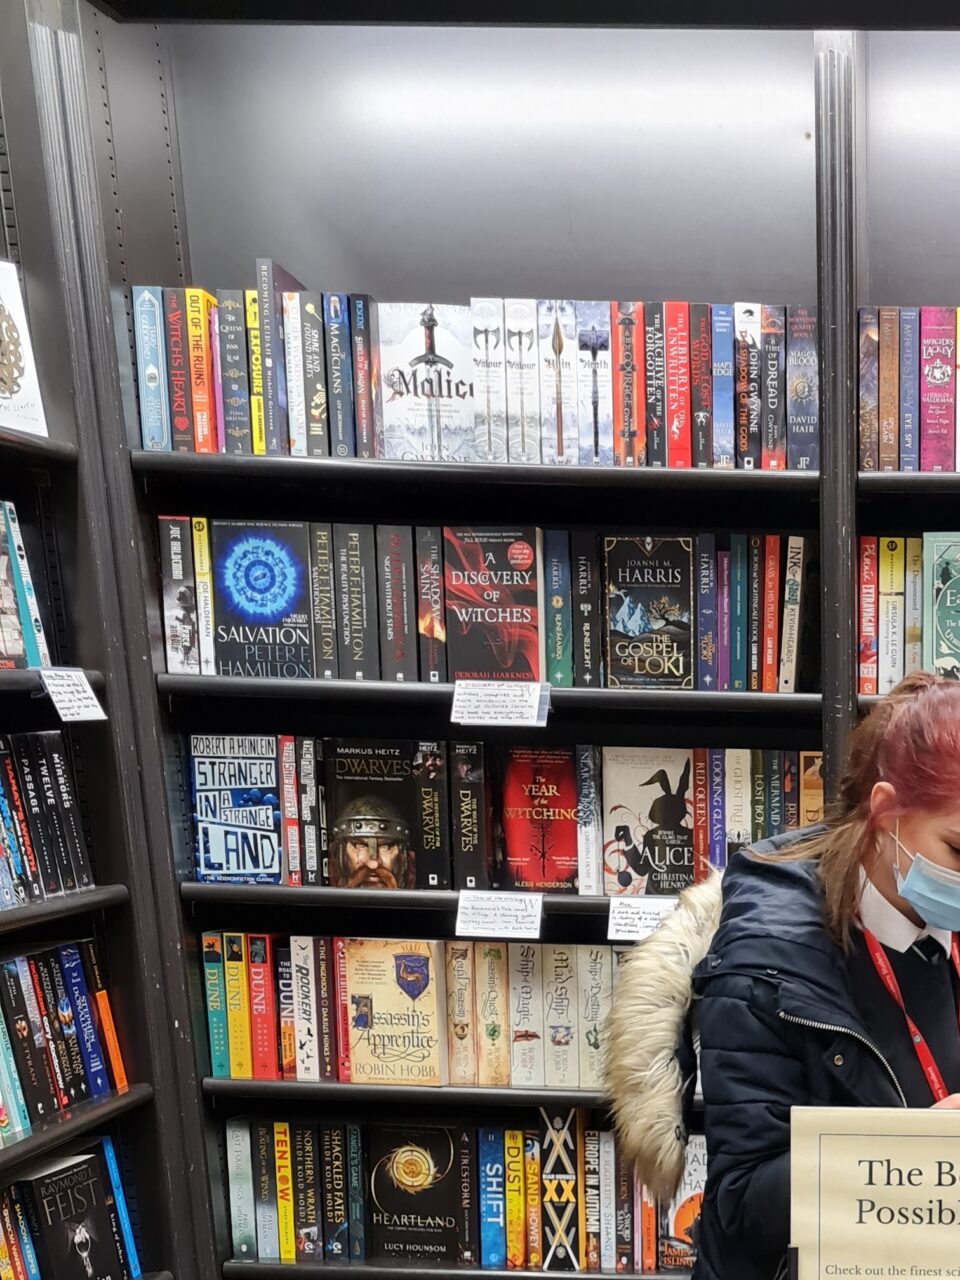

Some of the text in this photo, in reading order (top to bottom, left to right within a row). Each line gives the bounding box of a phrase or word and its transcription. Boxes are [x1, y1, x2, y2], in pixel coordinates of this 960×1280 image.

[618, 568, 681, 584] HARRIS
[218, 626, 310, 645] SALVATION
[615, 642, 682, 658] GOSPEL
[633, 656, 684, 676] LOKI
[196, 761, 275, 788] STRANGER
[335, 758, 413, 776] DWARVES
[205, 827, 276, 871] LAND
[640, 846, 694, 871] ALICE
[205, 968, 221, 1011] DUNE
[858, 1159, 923, 1186] The
[42, 1178, 99, 1226] FEIST
[486, 1163, 504, 1227] SHIFT
[373, 1213, 455, 1228] HEARTLAND
[825, 1265, 861, 1276] Check
[865, 1267, 884, 1276] out
[888, 1266, 907, 1276] the
[910, 1266, 942, 1277] finest
